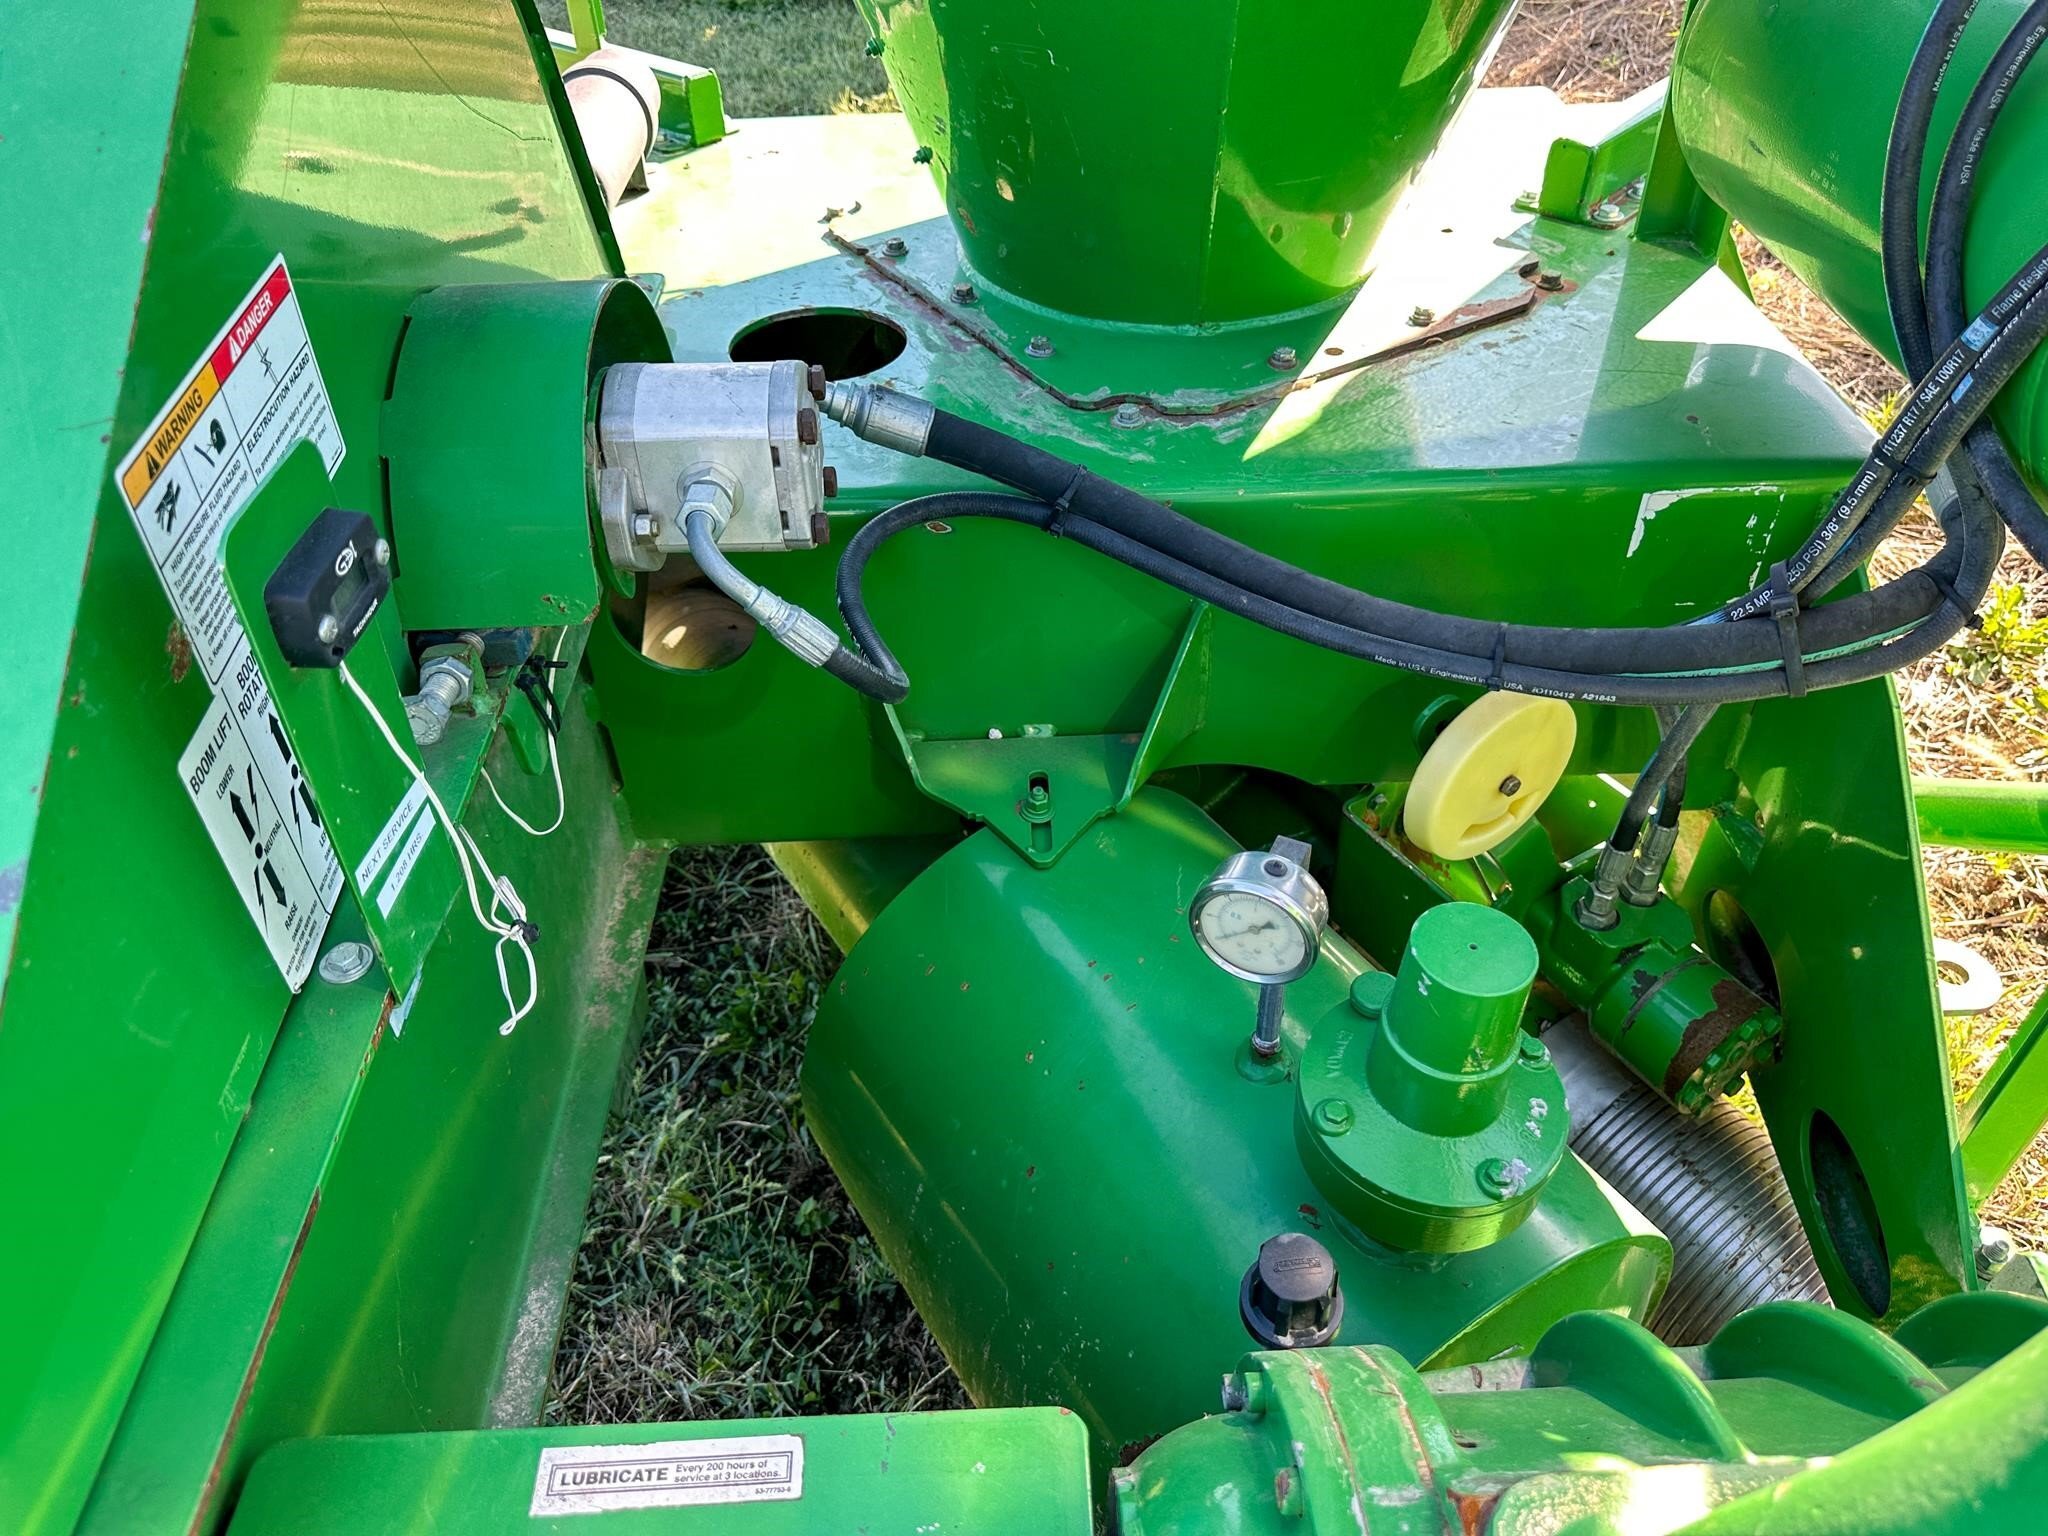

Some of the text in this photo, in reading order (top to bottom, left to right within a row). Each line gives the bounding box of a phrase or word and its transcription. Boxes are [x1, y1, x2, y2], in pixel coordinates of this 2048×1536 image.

[1949, 24, 1965, 49] USA
[1960, 24, 2046, 185] Engineered in USA Made in USA
[236, 290, 273, 348] DANGER
[154, 388, 203, 460] WARNING
[247, 352, 310, 454] ELECTROCUTION HAZARD
[260, 444, 276, 472] prevent
[1730, 603, 1755, 622] 22.5
[1802, 538, 1828, 565] PSI)
[1837, 495, 1858, 519] (9.5
[1854, 469, 1877, 498] mm)
[1902, 405, 1921, 427] R17
[1919, 381, 1940, 403] SAE
[1935, 348, 1966, 384] 100R17
[1991, 288, 2023, 319] Flame
[170, 459, 241, 573] HIGH PRESSURE FLUID HAZARD
[237, 669, 264, 721] ROTAT
[1375, 654, 1397, 666] Made
[1398, 660, 1406, 668] in
[1407, 662, 1426, 672] USA
[1429, 667, 1477, 683] Engineered
[1503, 680, 1523, 691] USA
[189, 712, 232, 796] BOOM LIFT
[216, 763, 235, 800] LOWER
[263, 819, 282, 856] NEUTRAL
[361, 800, 414, 882] NEXT SERVICE
[284, 901, 299, 931] RAISE
[560, 1459, 768, 1486] LUBRICATE Every 200 hours of
[674, 1469, 782, 1483] service at 3 locations.
